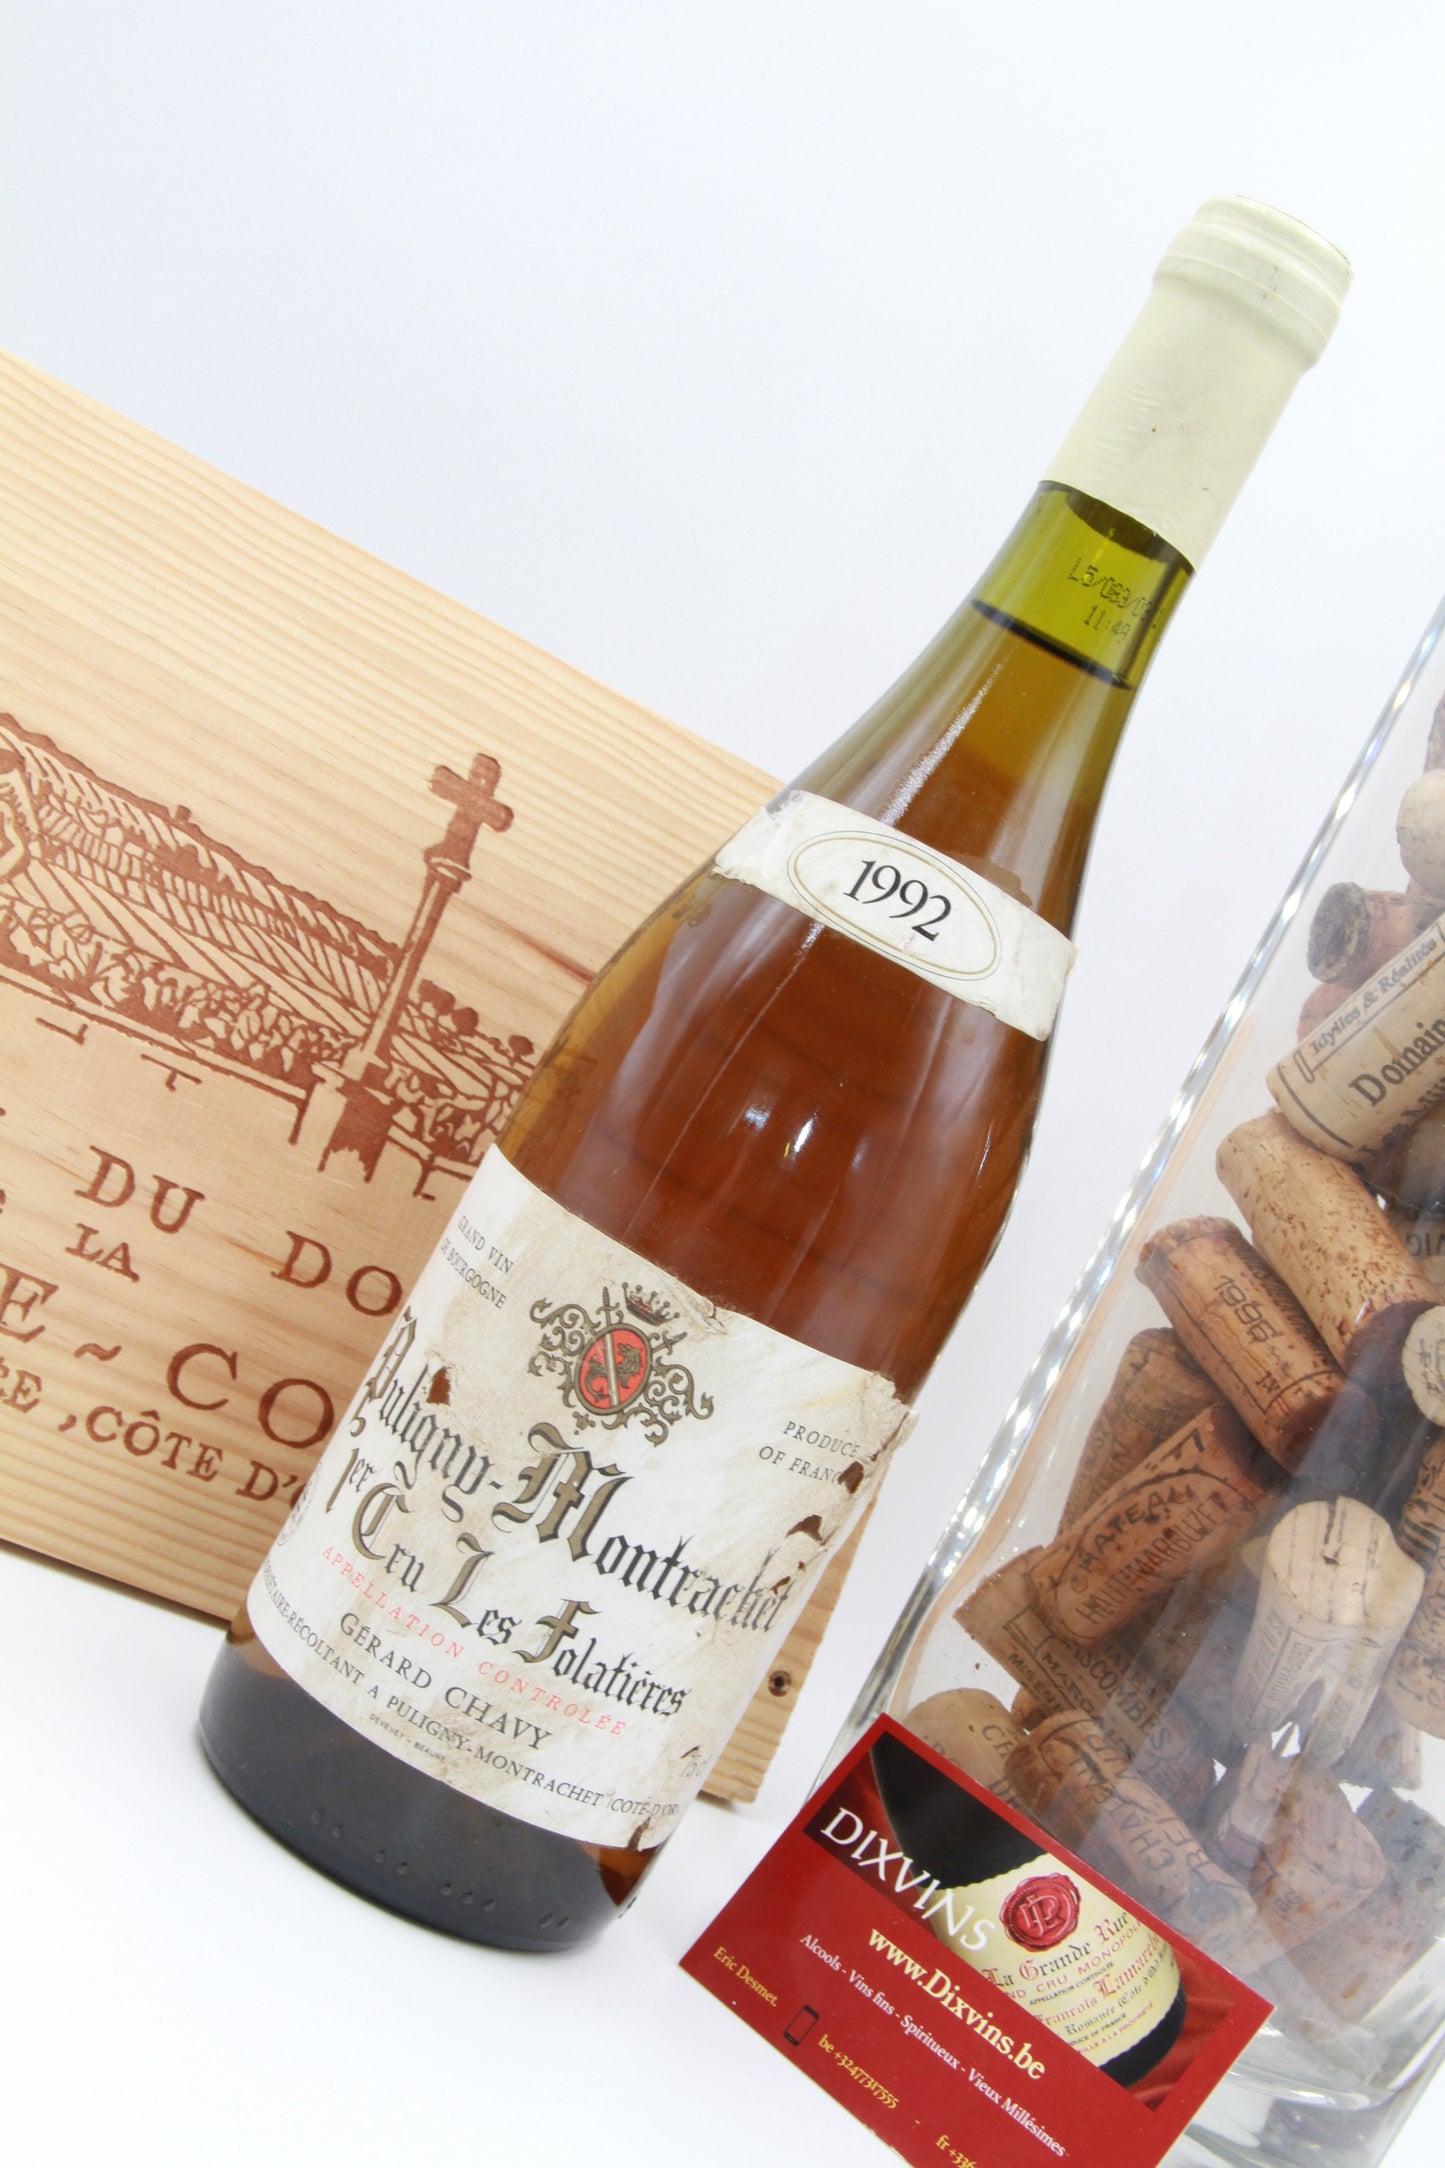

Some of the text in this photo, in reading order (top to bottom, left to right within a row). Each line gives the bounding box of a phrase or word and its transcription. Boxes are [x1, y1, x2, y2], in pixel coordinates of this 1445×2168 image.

[842, 859, 952, 942] 1992
[74, 1145, 206, 1235] DU
[64, 1223, 141, 1283] LA
[446, 1247, 508, 1310] BOURGOGNE
[457, 1215, 515, 1275] GRAND VIN
[1213, 1274, 1281, 1344] 1996
[758, 1445, 787, 1465] OF
[783, 1420, 861, 1458] PRODUCE
[352, 1482, 425, 1594] Cru
[428, 1531, 523, 1647] Les
[321, 1545, 628, 1737] APPELLATION CONTROLÉE
[339, 1611, 553, 1751] GÉRARD CHAVY
[386, 1694, 604, 1808] PULIGNY-MONTRACHET
[820, 1806, 995, 1951] DIXVINS
[713, 1945, 738, 1972] Eric
[1018, 1941, 1091, 1981] Grande
[1036, 1974, 1069, 1993] CRU
[800, 1933, 842, 1972] Alcools
[849, 1968, 875, 1998] Vins
[872, 1991, 897, 2017] fins
[900, 2014, 962, 2071] Spiritueux
[968, 2066, 1003, 2105] Vieux
[1000, 2096, 1068, 2158] Millésimes
[868, 1928, 1046, 2080] www.Dixvins.be
[817, 2033, 835, 2054] be
[935, 2134, 950, 2151] fr
